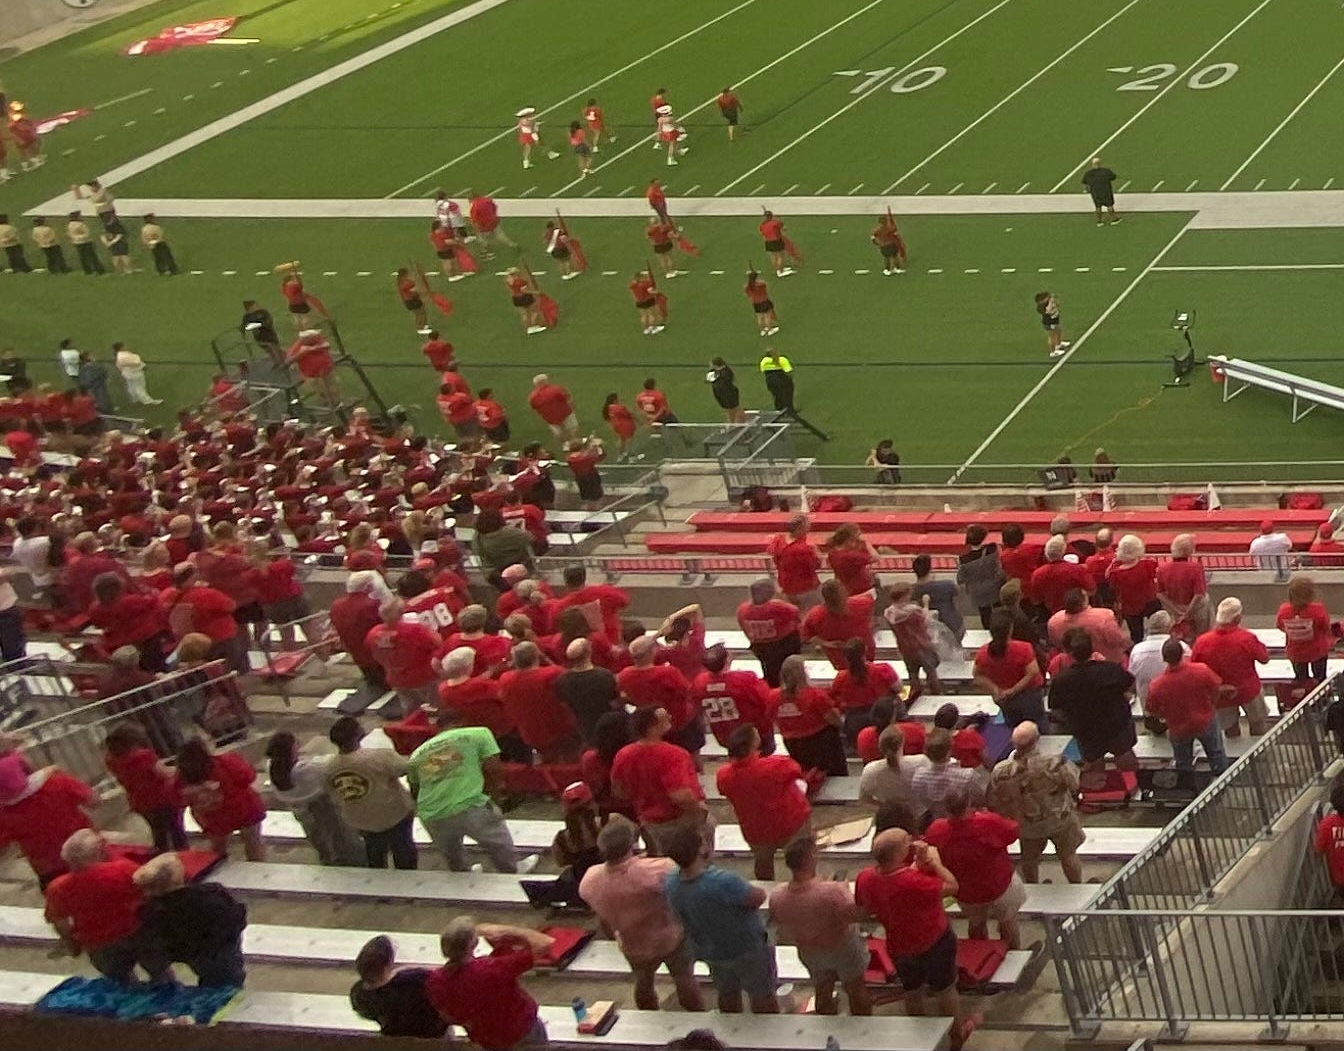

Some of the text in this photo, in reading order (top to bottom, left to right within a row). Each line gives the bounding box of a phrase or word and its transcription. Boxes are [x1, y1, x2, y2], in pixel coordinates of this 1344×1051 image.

[849, 65, 947, 94] 10
[1115, 62, 1239, 91] 20
[702, 697, 739, 723] 28
